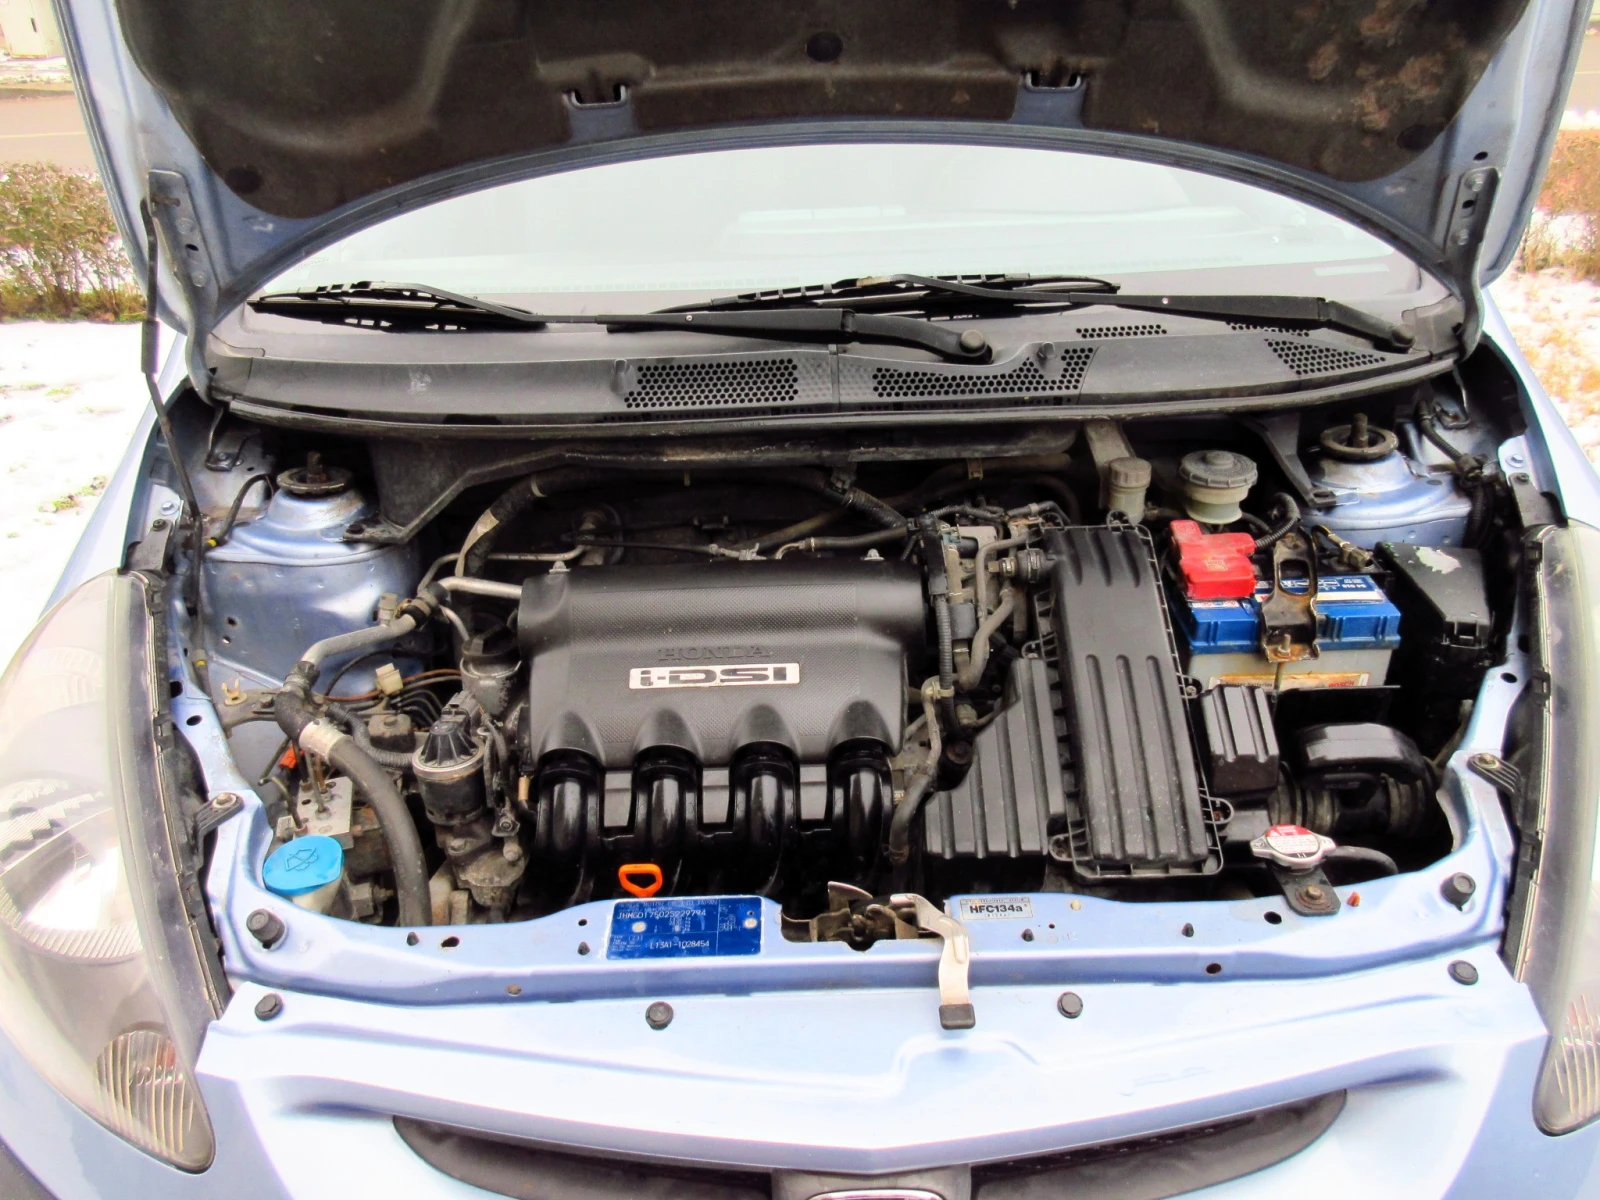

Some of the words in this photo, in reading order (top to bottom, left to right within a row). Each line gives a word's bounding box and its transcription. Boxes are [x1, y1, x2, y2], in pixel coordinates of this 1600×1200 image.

[658, 646, 770, 661] HONDA
[640, 667, 787, 687] i-DSI
[969, 904, 1023, 914] HFC134a
